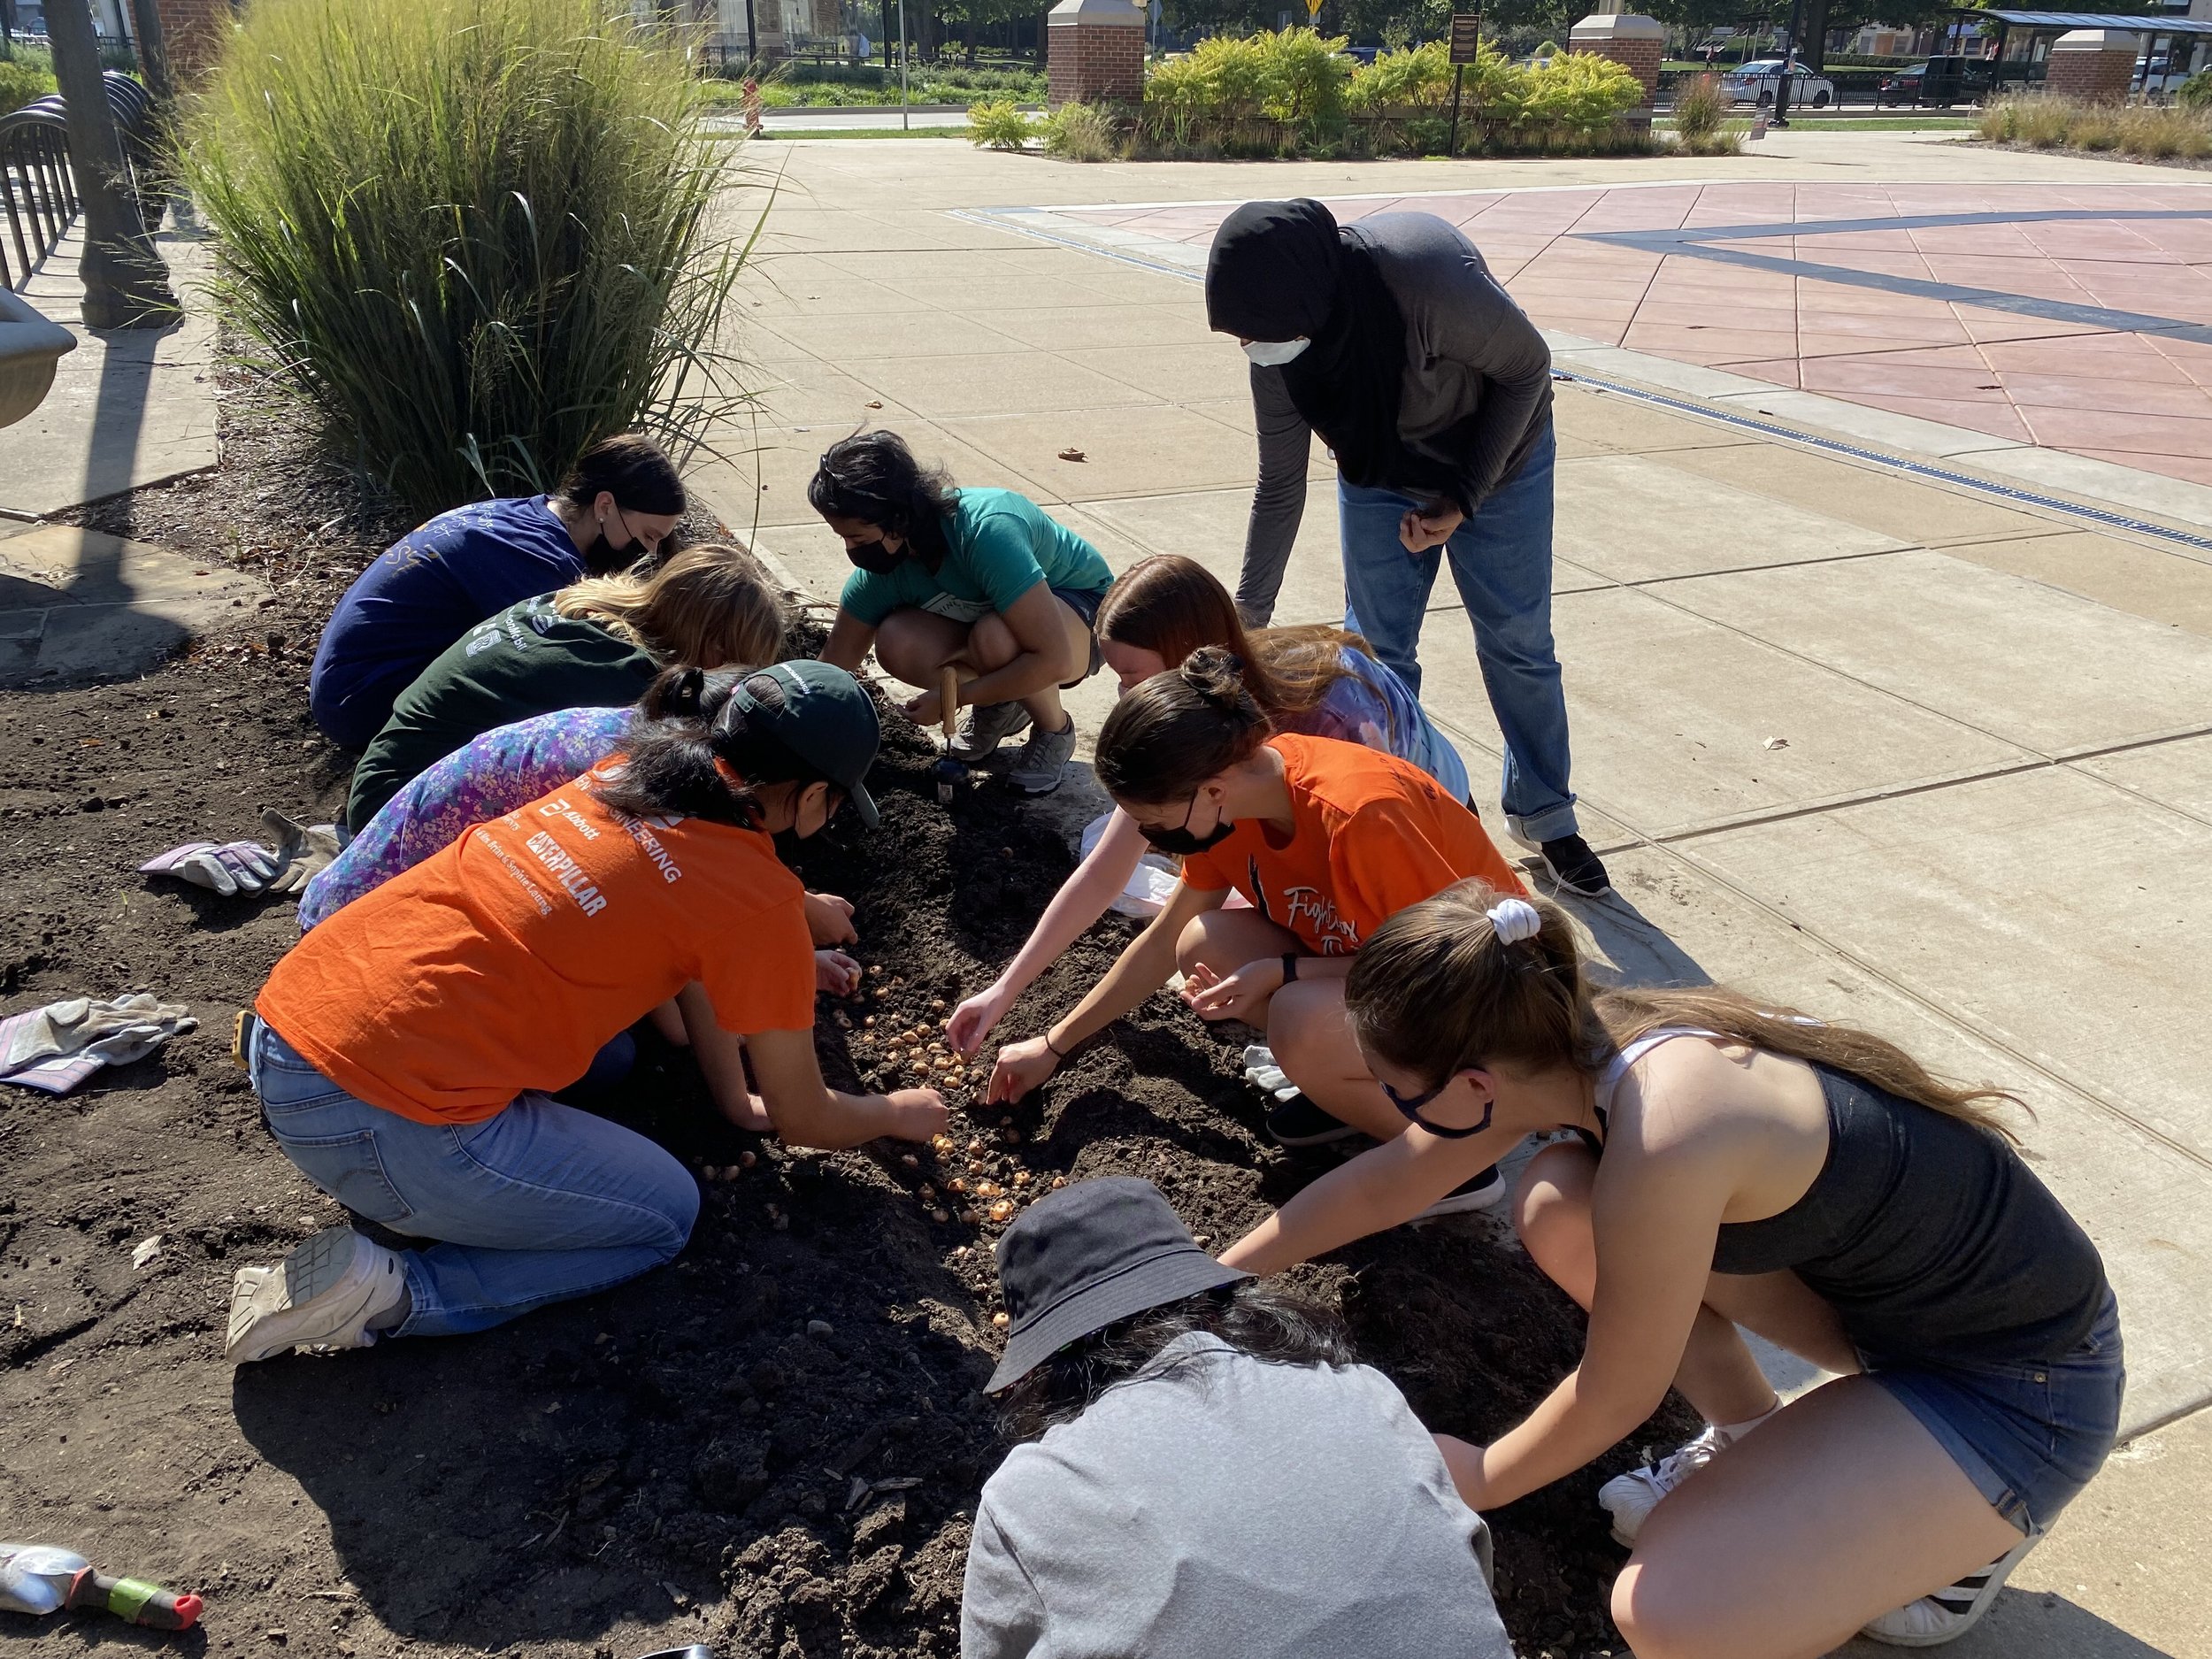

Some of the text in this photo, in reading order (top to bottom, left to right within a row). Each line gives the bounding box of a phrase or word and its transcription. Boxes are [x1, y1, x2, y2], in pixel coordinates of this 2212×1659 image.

[564, 811, 601, 841] Abbott
[488, 840, 504, 859] Brian
[501, 855, 511, 865] &
[507, 860, 530, 887] Sophie
[526, 831, 608, 917] CATERPILLAR
[1284, 886, 1359, 942] Fighting
